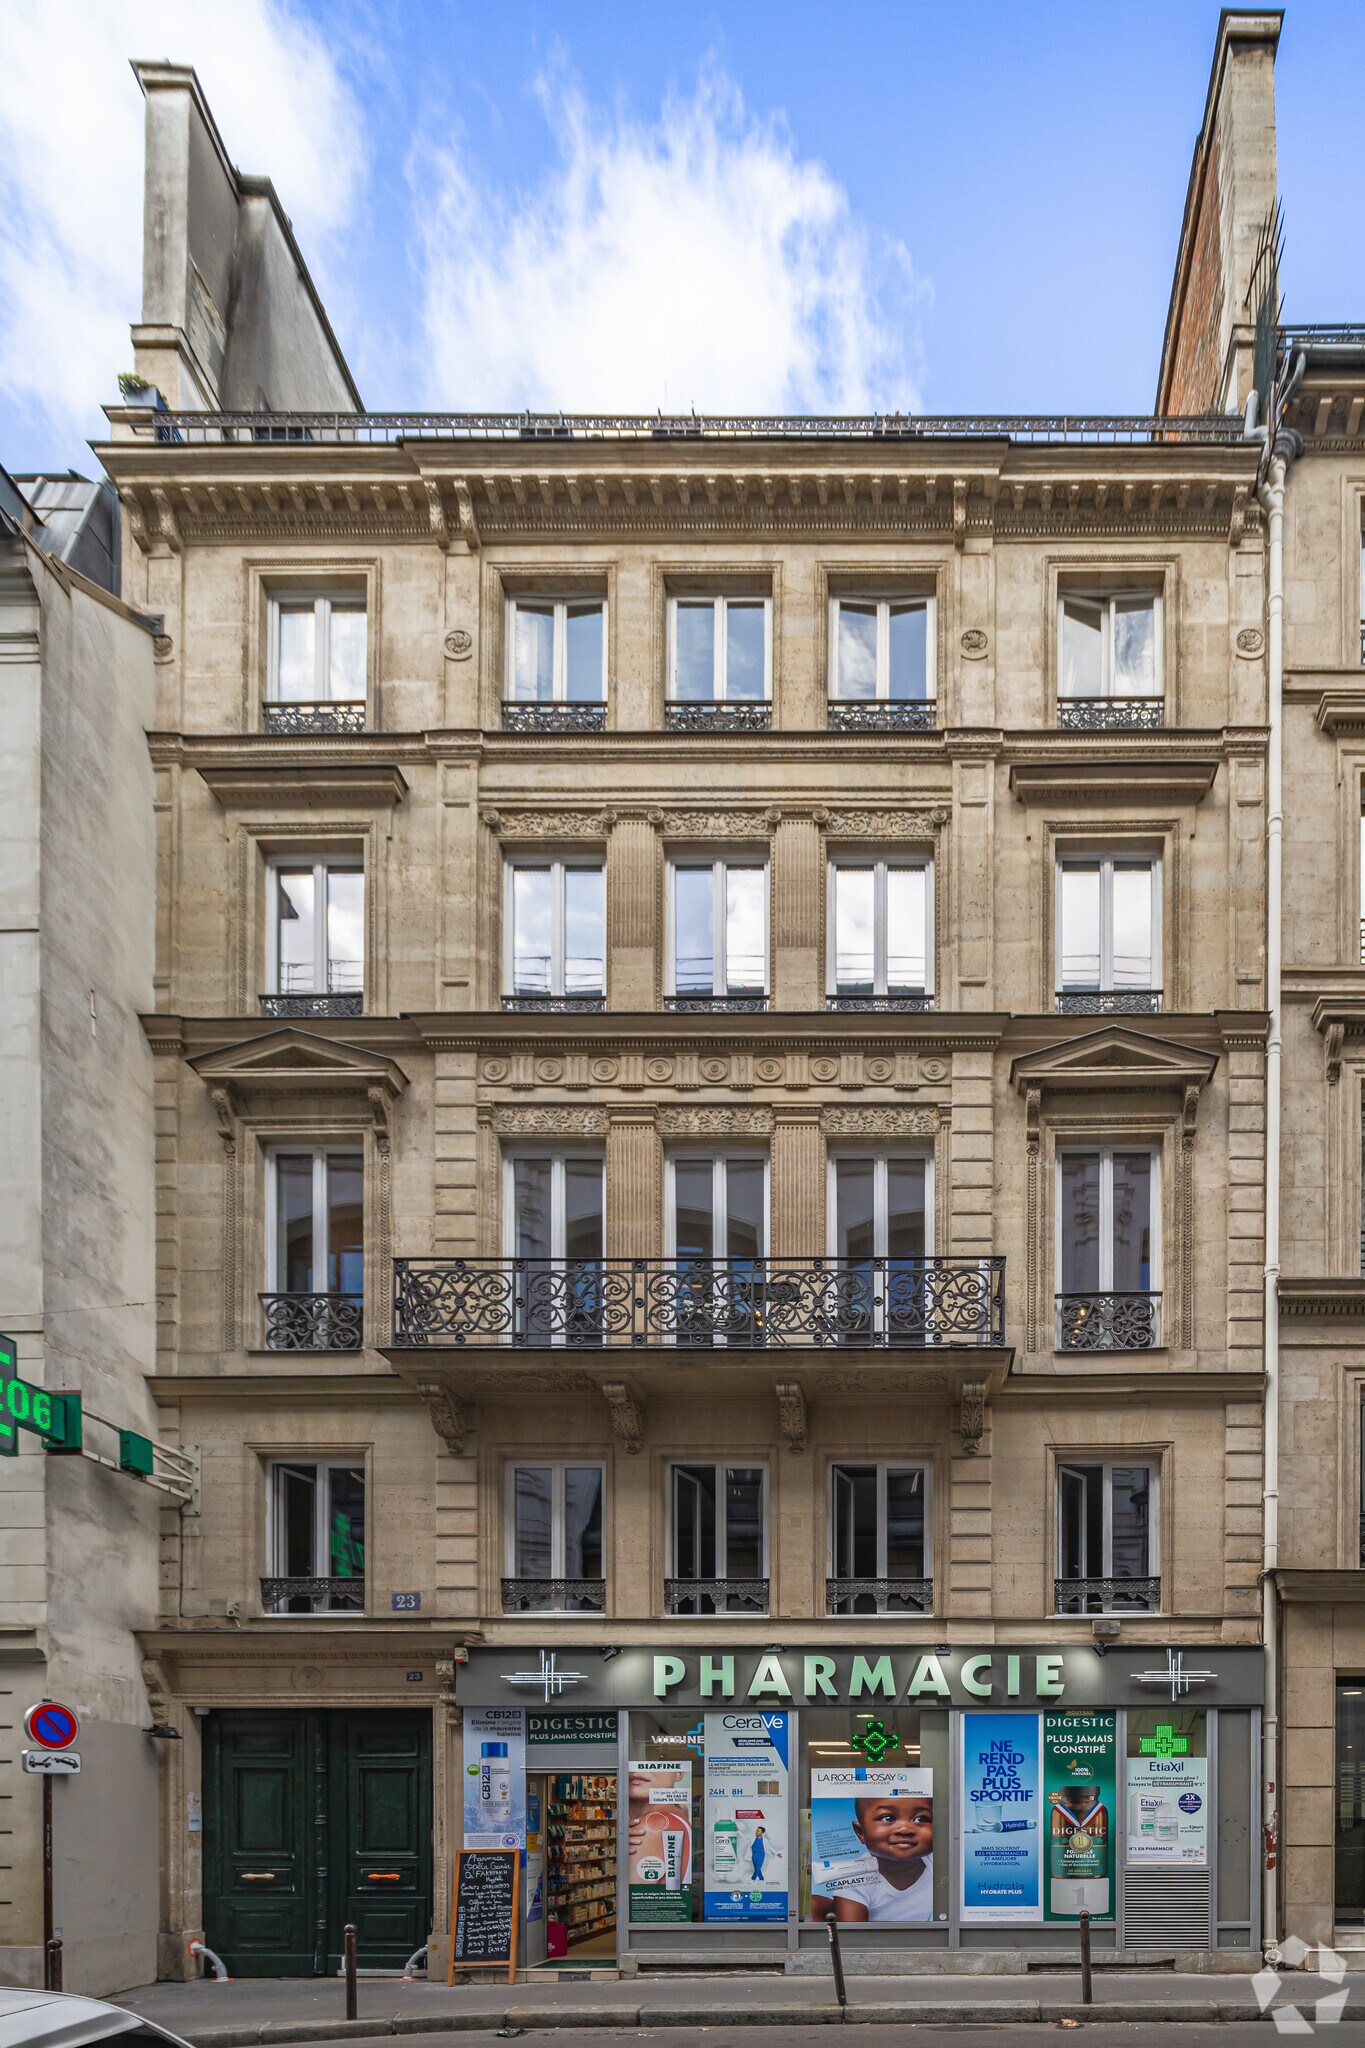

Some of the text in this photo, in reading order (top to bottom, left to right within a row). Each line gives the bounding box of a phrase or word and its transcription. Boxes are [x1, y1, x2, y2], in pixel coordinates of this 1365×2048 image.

[396, 1594, 416, 1608] 23
[653, 1654, 1066, 1697] PHARMACIE
[485, 1710, 511, 1719] CB12
[529, 1717, 616, 1730] DIGESTIC
[722, 1715, 783, 1729] CeraVe
[1046, 1718, 1114, 1727] DIGESTIC
[651, 1735, 705, 1744] VITRINE
[1047, 1735, 1113, 1743] PLUS JAMAIS
[990, 1740, 1013, 1752] NE
[1053, 1744, 1106, 1754] CONSTIPÉ
[979, 1753, 1025, 1764] REND
[986, 1765, 1017, 1777] PAS
[1149, 1761, 1184, 1773] EtiaXil
[482, 1774, 491, 1800] CB12
[982, 1778, 1021, 1789] PLUS
[970, 1790, 1034, 1801] SPORTIF
[667, 1835, 676, 1877] BIAFINE
[825, 1877, 866, 1889] CICAPLAST
[978, 1882, 1025, 1892] Hydratis
[1072, 1887, 1089, 1907] 1
